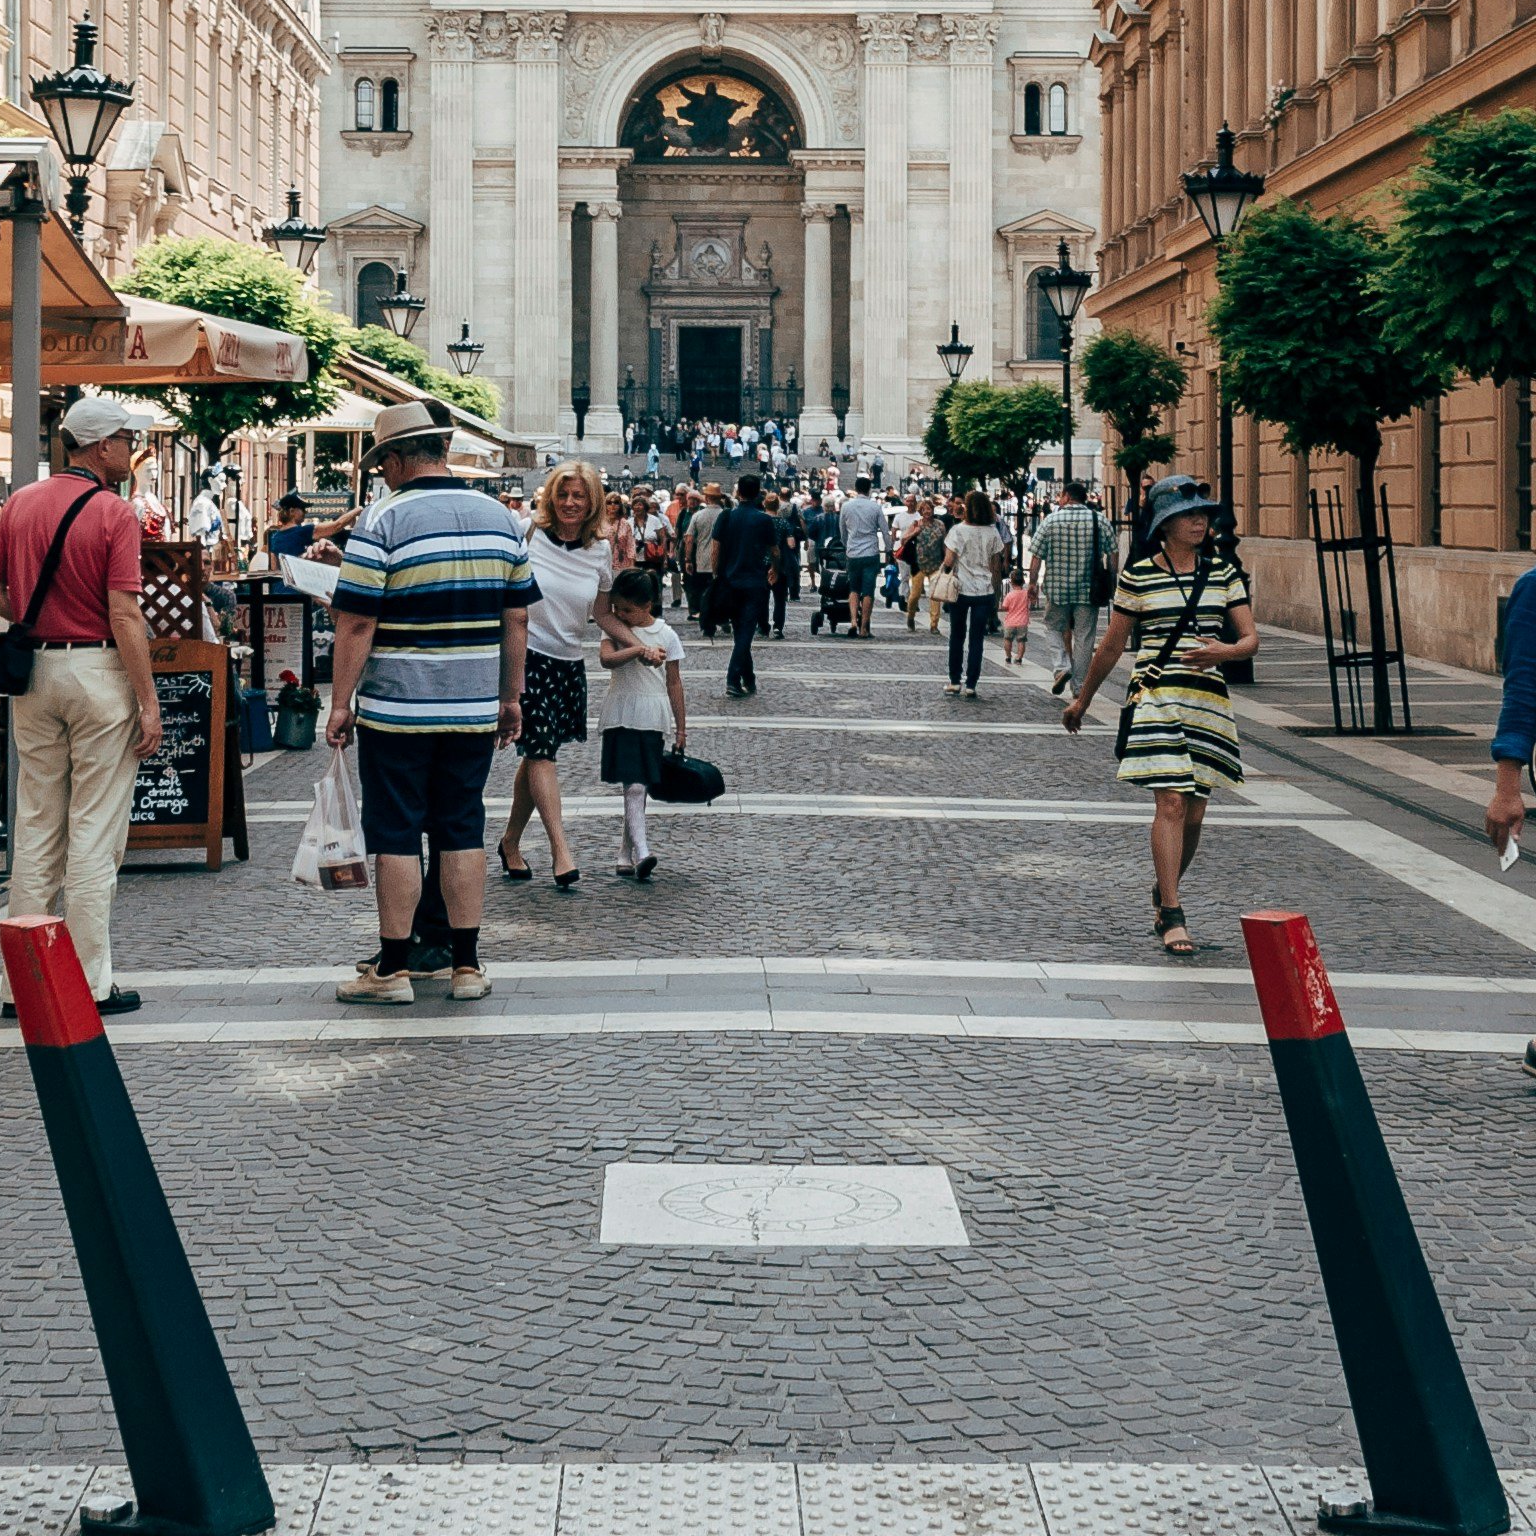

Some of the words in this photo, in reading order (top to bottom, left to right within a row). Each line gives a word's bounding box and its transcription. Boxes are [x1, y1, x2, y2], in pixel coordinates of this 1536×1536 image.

[134, 775, 155, 787] ola
[140, 796, 190, 815] Orange
[129, 810, 156, 821] uice
